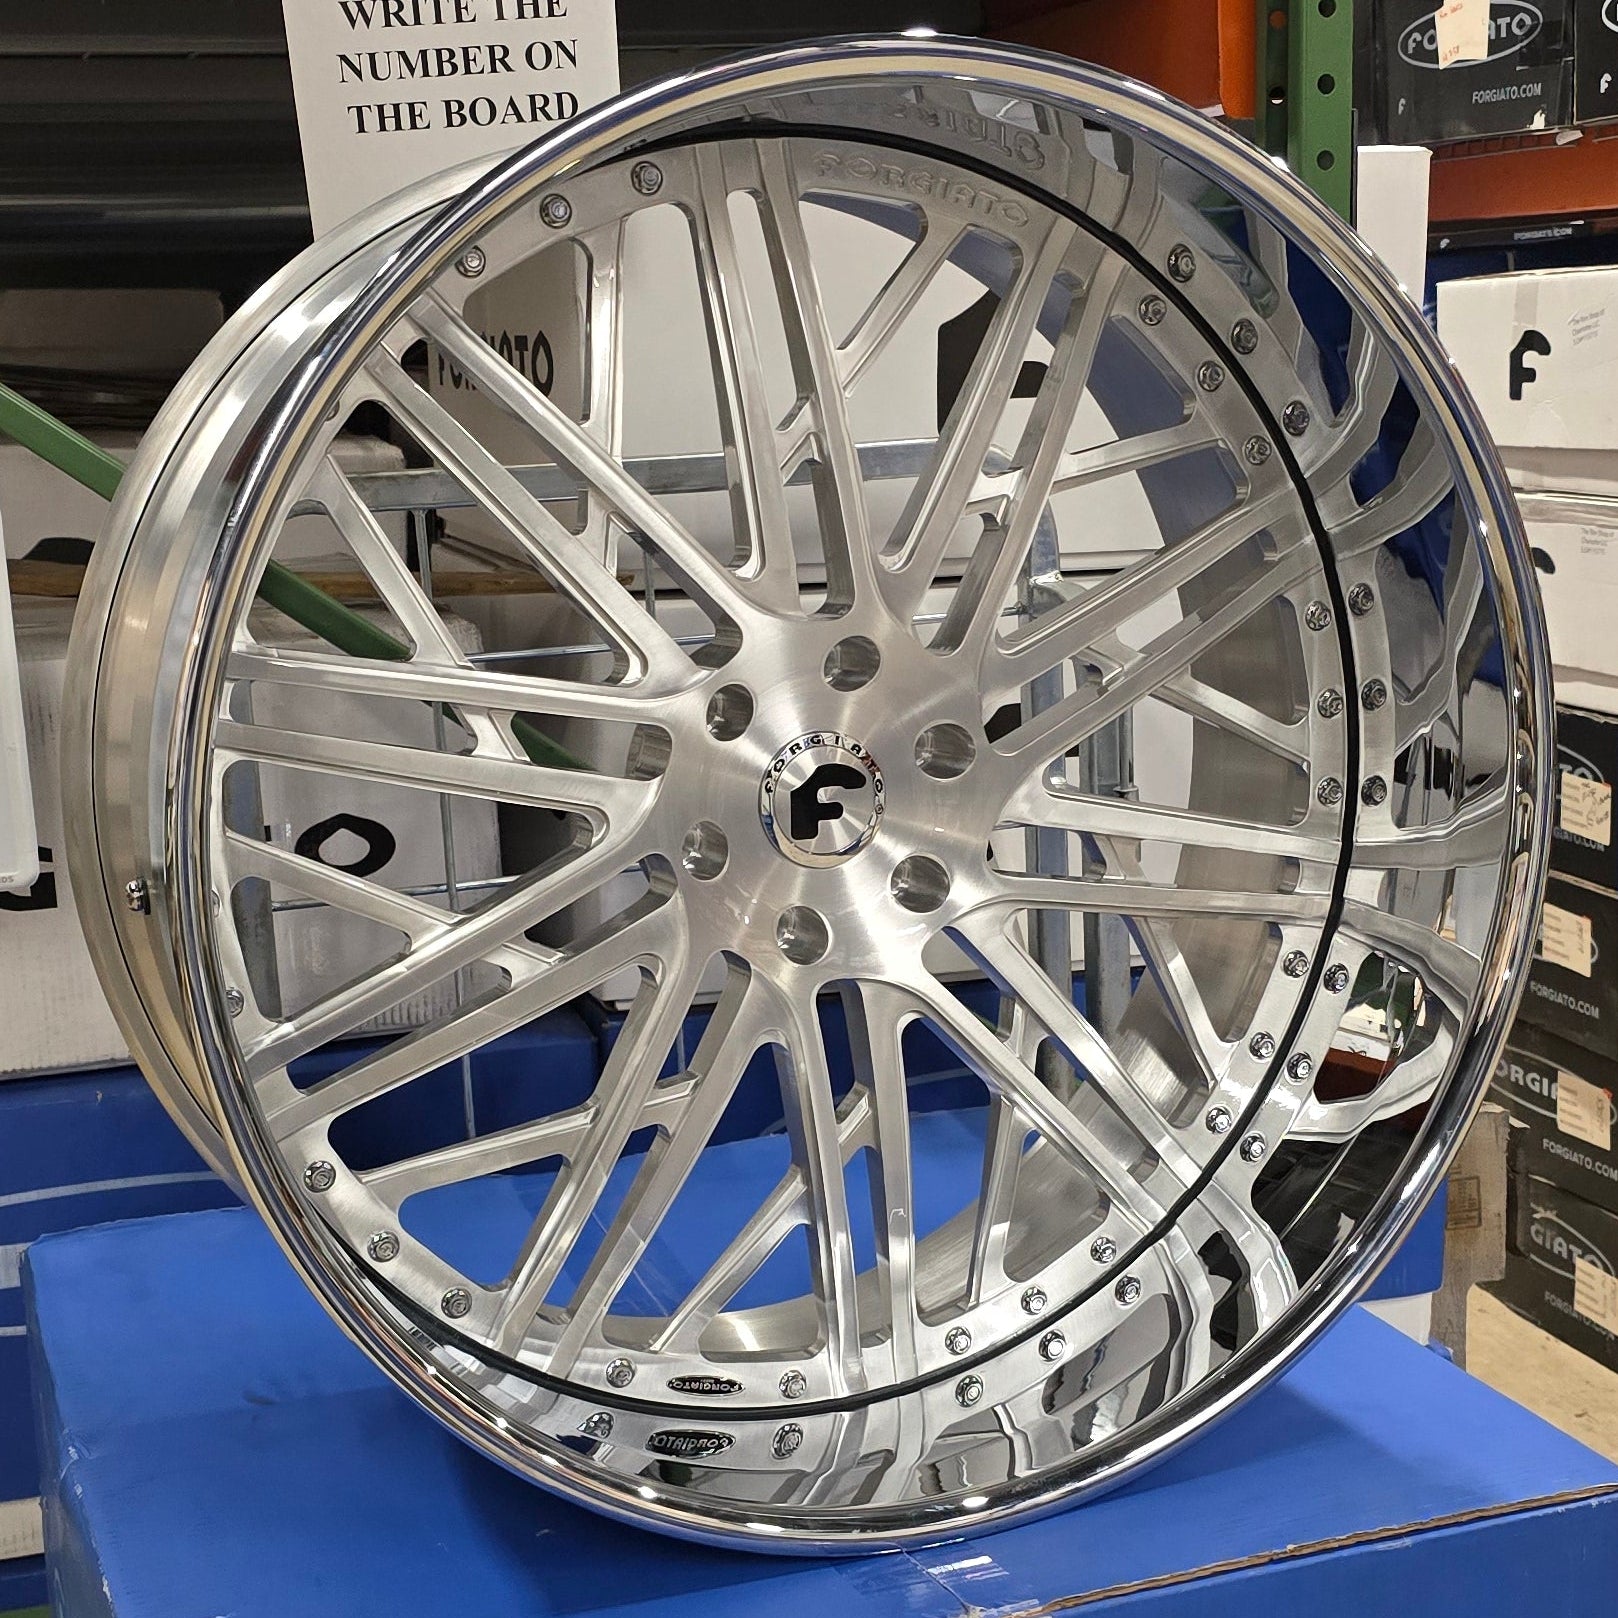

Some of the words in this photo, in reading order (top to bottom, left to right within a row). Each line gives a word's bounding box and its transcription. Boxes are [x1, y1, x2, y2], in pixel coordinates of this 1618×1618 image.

[339, 0, 477, 31] WRITE
[493, 0, 568, 21] THE
[336, 44, 516, 84] NUMBER
[525, 39, 578, 70] ON
[347, 101, 431, 134] THE
[441, 91, 579, 129] BOARD
[1472, 83, 1542, 104] FORGIATO.COM
[814, 152, 1029, 228] FORGIATO
[764, 734, 884, 795] FORGIATO
[1529, 979, 1600, 1020] FORGIATO.COM
[1543, 1138, 1618, 1182] FORGIATO.COM
[672, 1381, 739, 1391] FORGIATO
